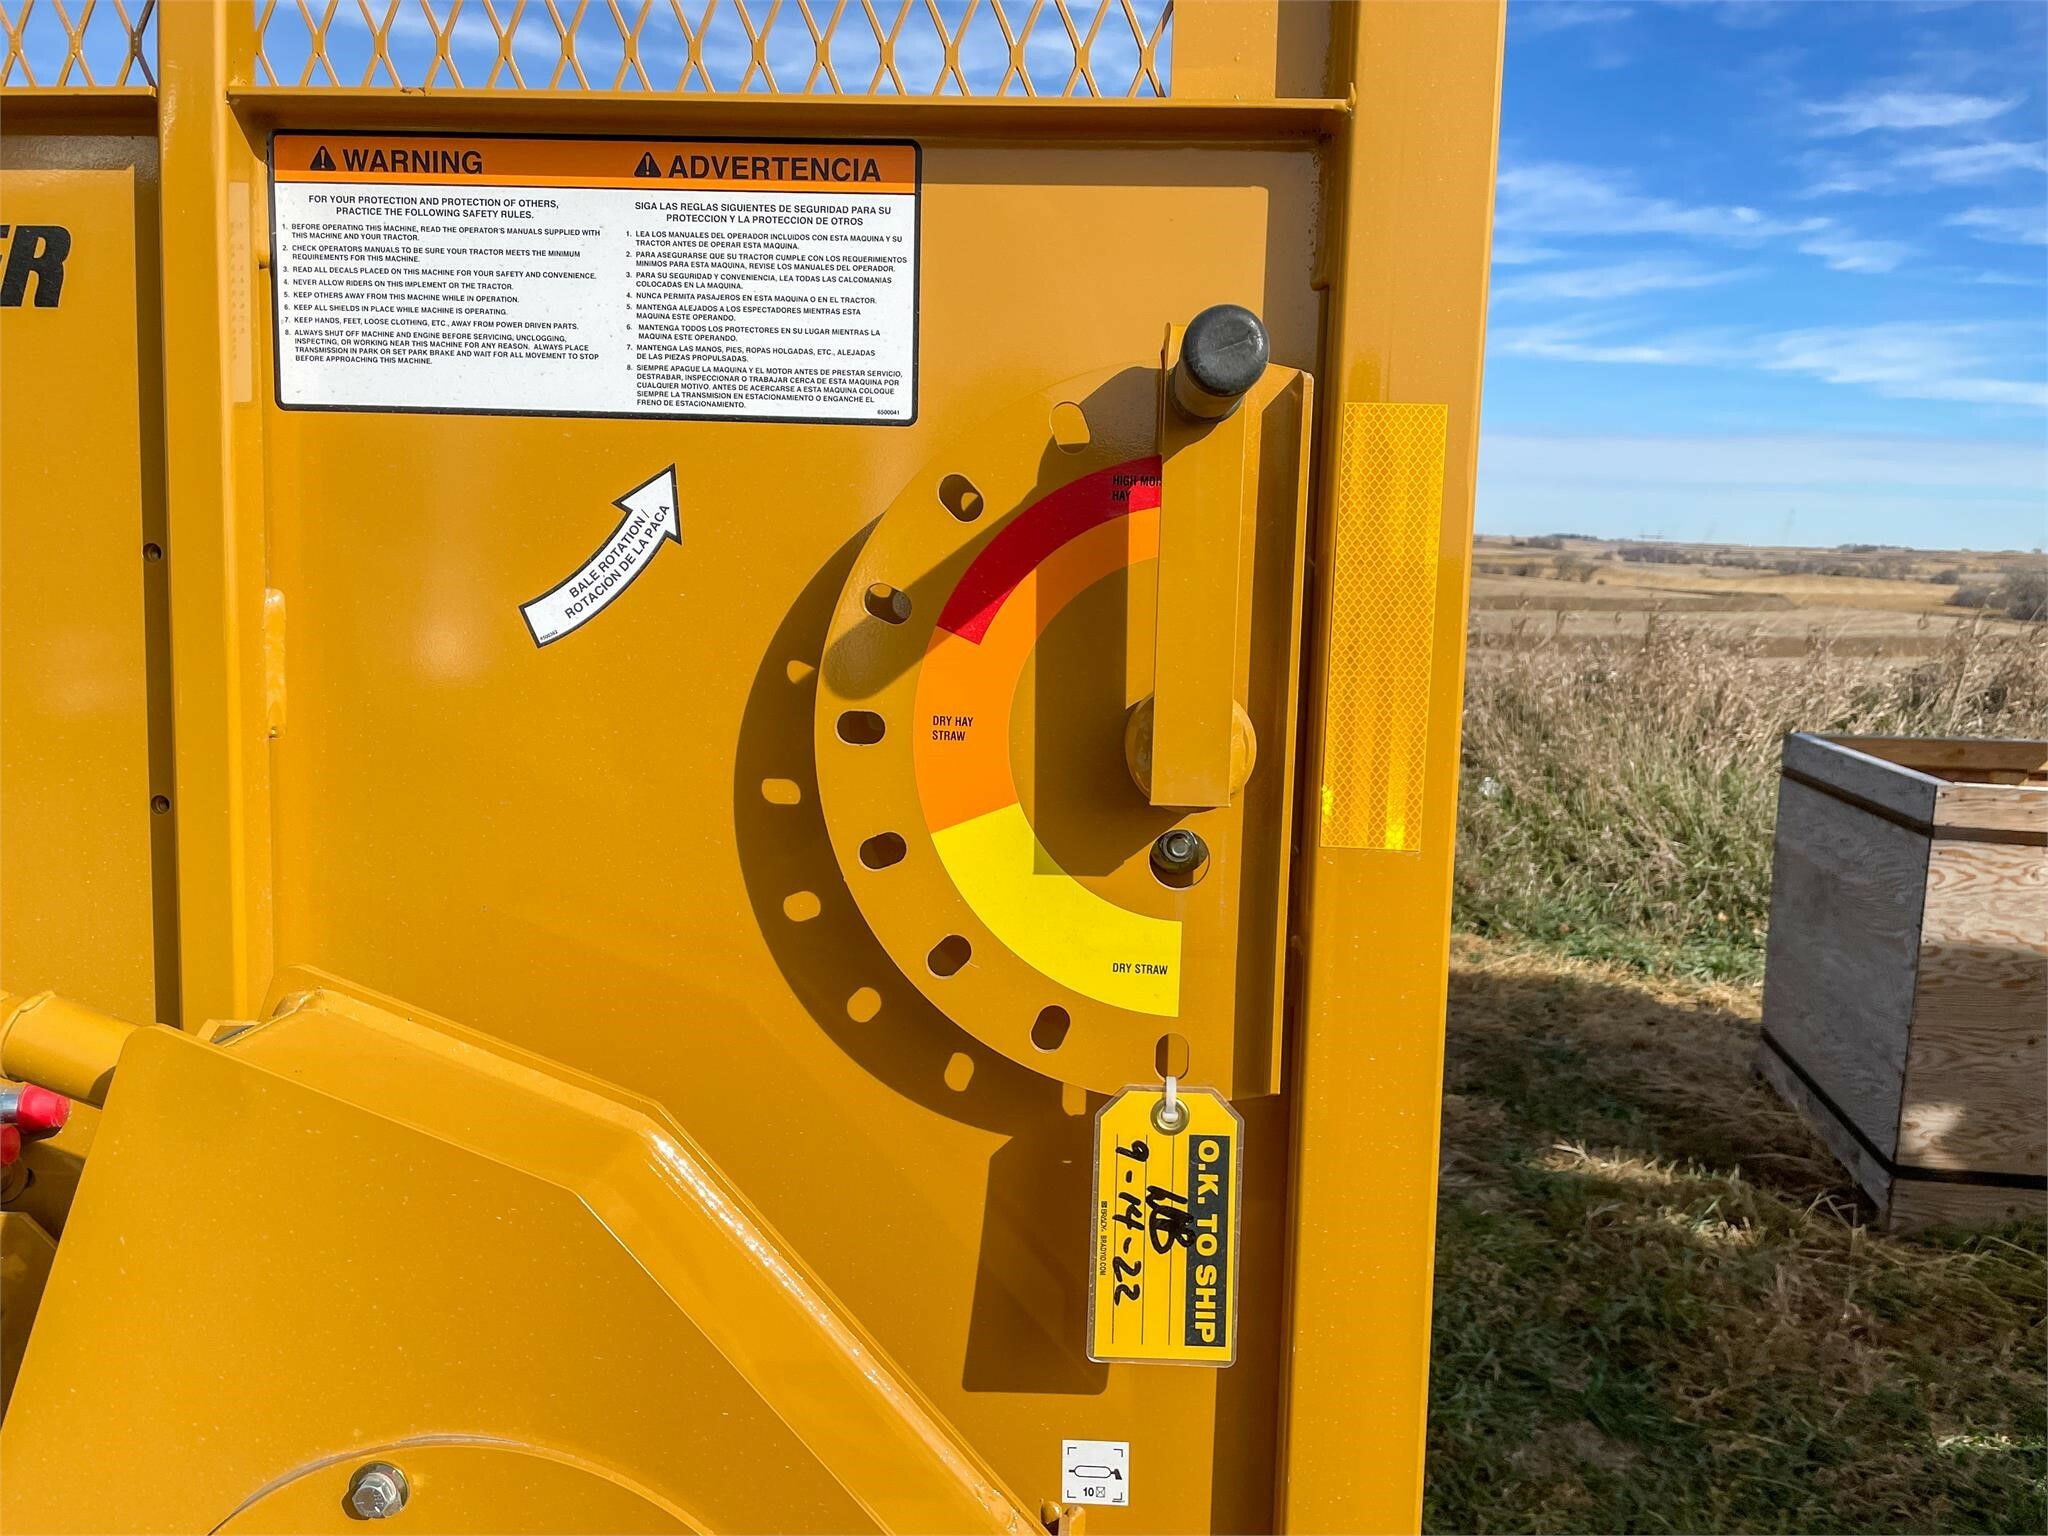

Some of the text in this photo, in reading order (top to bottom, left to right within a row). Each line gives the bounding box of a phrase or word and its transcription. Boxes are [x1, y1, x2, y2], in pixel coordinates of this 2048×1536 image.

[342, 149, 483, 174] WARNING
[668, 155, 881, 182] ADVERTENCIA
[308, 194, 558, 208] FOR YOUR PROTECTION AND PROTECTION OF OTHERS,
[336, 206, 534, 218] PRACTICE THE FOLLOWING SAFETY RULES.
[635, 201, 891, 214] SIGA LAS REGLAS SIGUIENTES DE SEGURIDAD PARA SU
[666, 213, 726, 223] PROTECCION
[738, 215, 750, 223] LA
[752, 215, 813, 224] PROTECCION
[815, 216, 828, 225] DE
[830, 216, 863, 225] OTROS
[322, 223, 363, 231] OPERATING
[458, 226, 505, 234] OPERATOR'S
[506, 227, 542, 235] MANUALS
[421, 268, 454, 276] MACHINE
[542, 271, 596, 279] CONVENIENCE.
[477, 282, 512, 290] TRACTOR.
[696, 293, 740, 301] PASAJEROS
[343, 317, 362, 325] FEET,
[390, 318, 429, 326] CLOTHING,
[295, 354, 323, 362] BEFORE
[325, 355, 378, 363] APPROACHING
[692, 354, 748, 362] PROPULSADAS.
[681, 391, 731, 399] TRANSMISION
[745, 393, 814, 401] ESTACIONAMIENTO
[675, 399, 745, 408] ESTACIONAMIENTO.
[1113, 475, 1137, 486] HIGH
[1113, 490, 1132, 501] HAY
[564, 504, 670, 619] ROTACIÓN DE LA PACA
[568, 569, 600, 598] BALE
[598, 515, 646, 573] ROTATION
[932, 715, 974, 727] DRY HAY
[932, 729, 966, 741] STRAW
[1112, 962, 1168, 975] DRY STRAW
[1194, 1139, 1220, 1344] O.K. TO SHIP
[1083, 1486, 1095, 1497] 10
